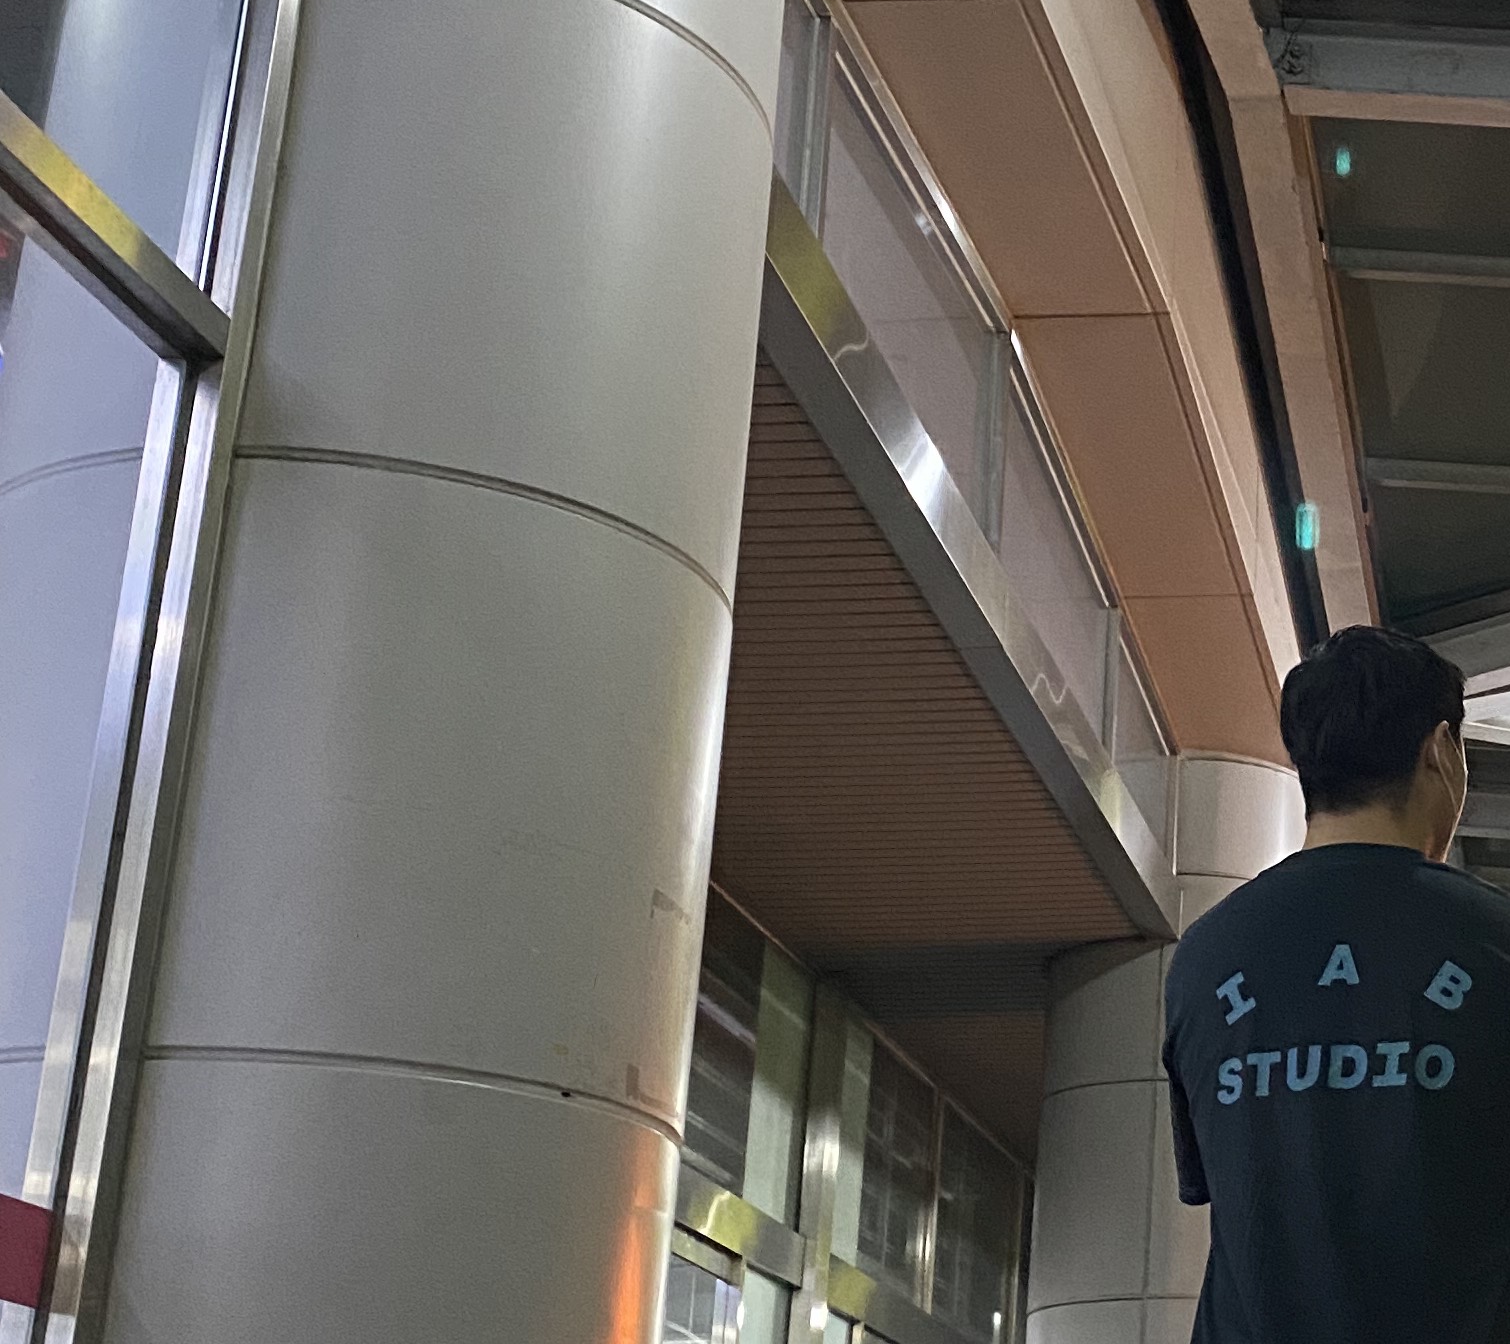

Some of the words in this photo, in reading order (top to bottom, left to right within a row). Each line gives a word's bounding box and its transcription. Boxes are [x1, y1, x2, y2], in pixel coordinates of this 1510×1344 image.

[1317, 943, 1361, 987] A
[1423, 959, 1473, 1011] B
[1216, 1040, 1456, 1106] STUDIO
